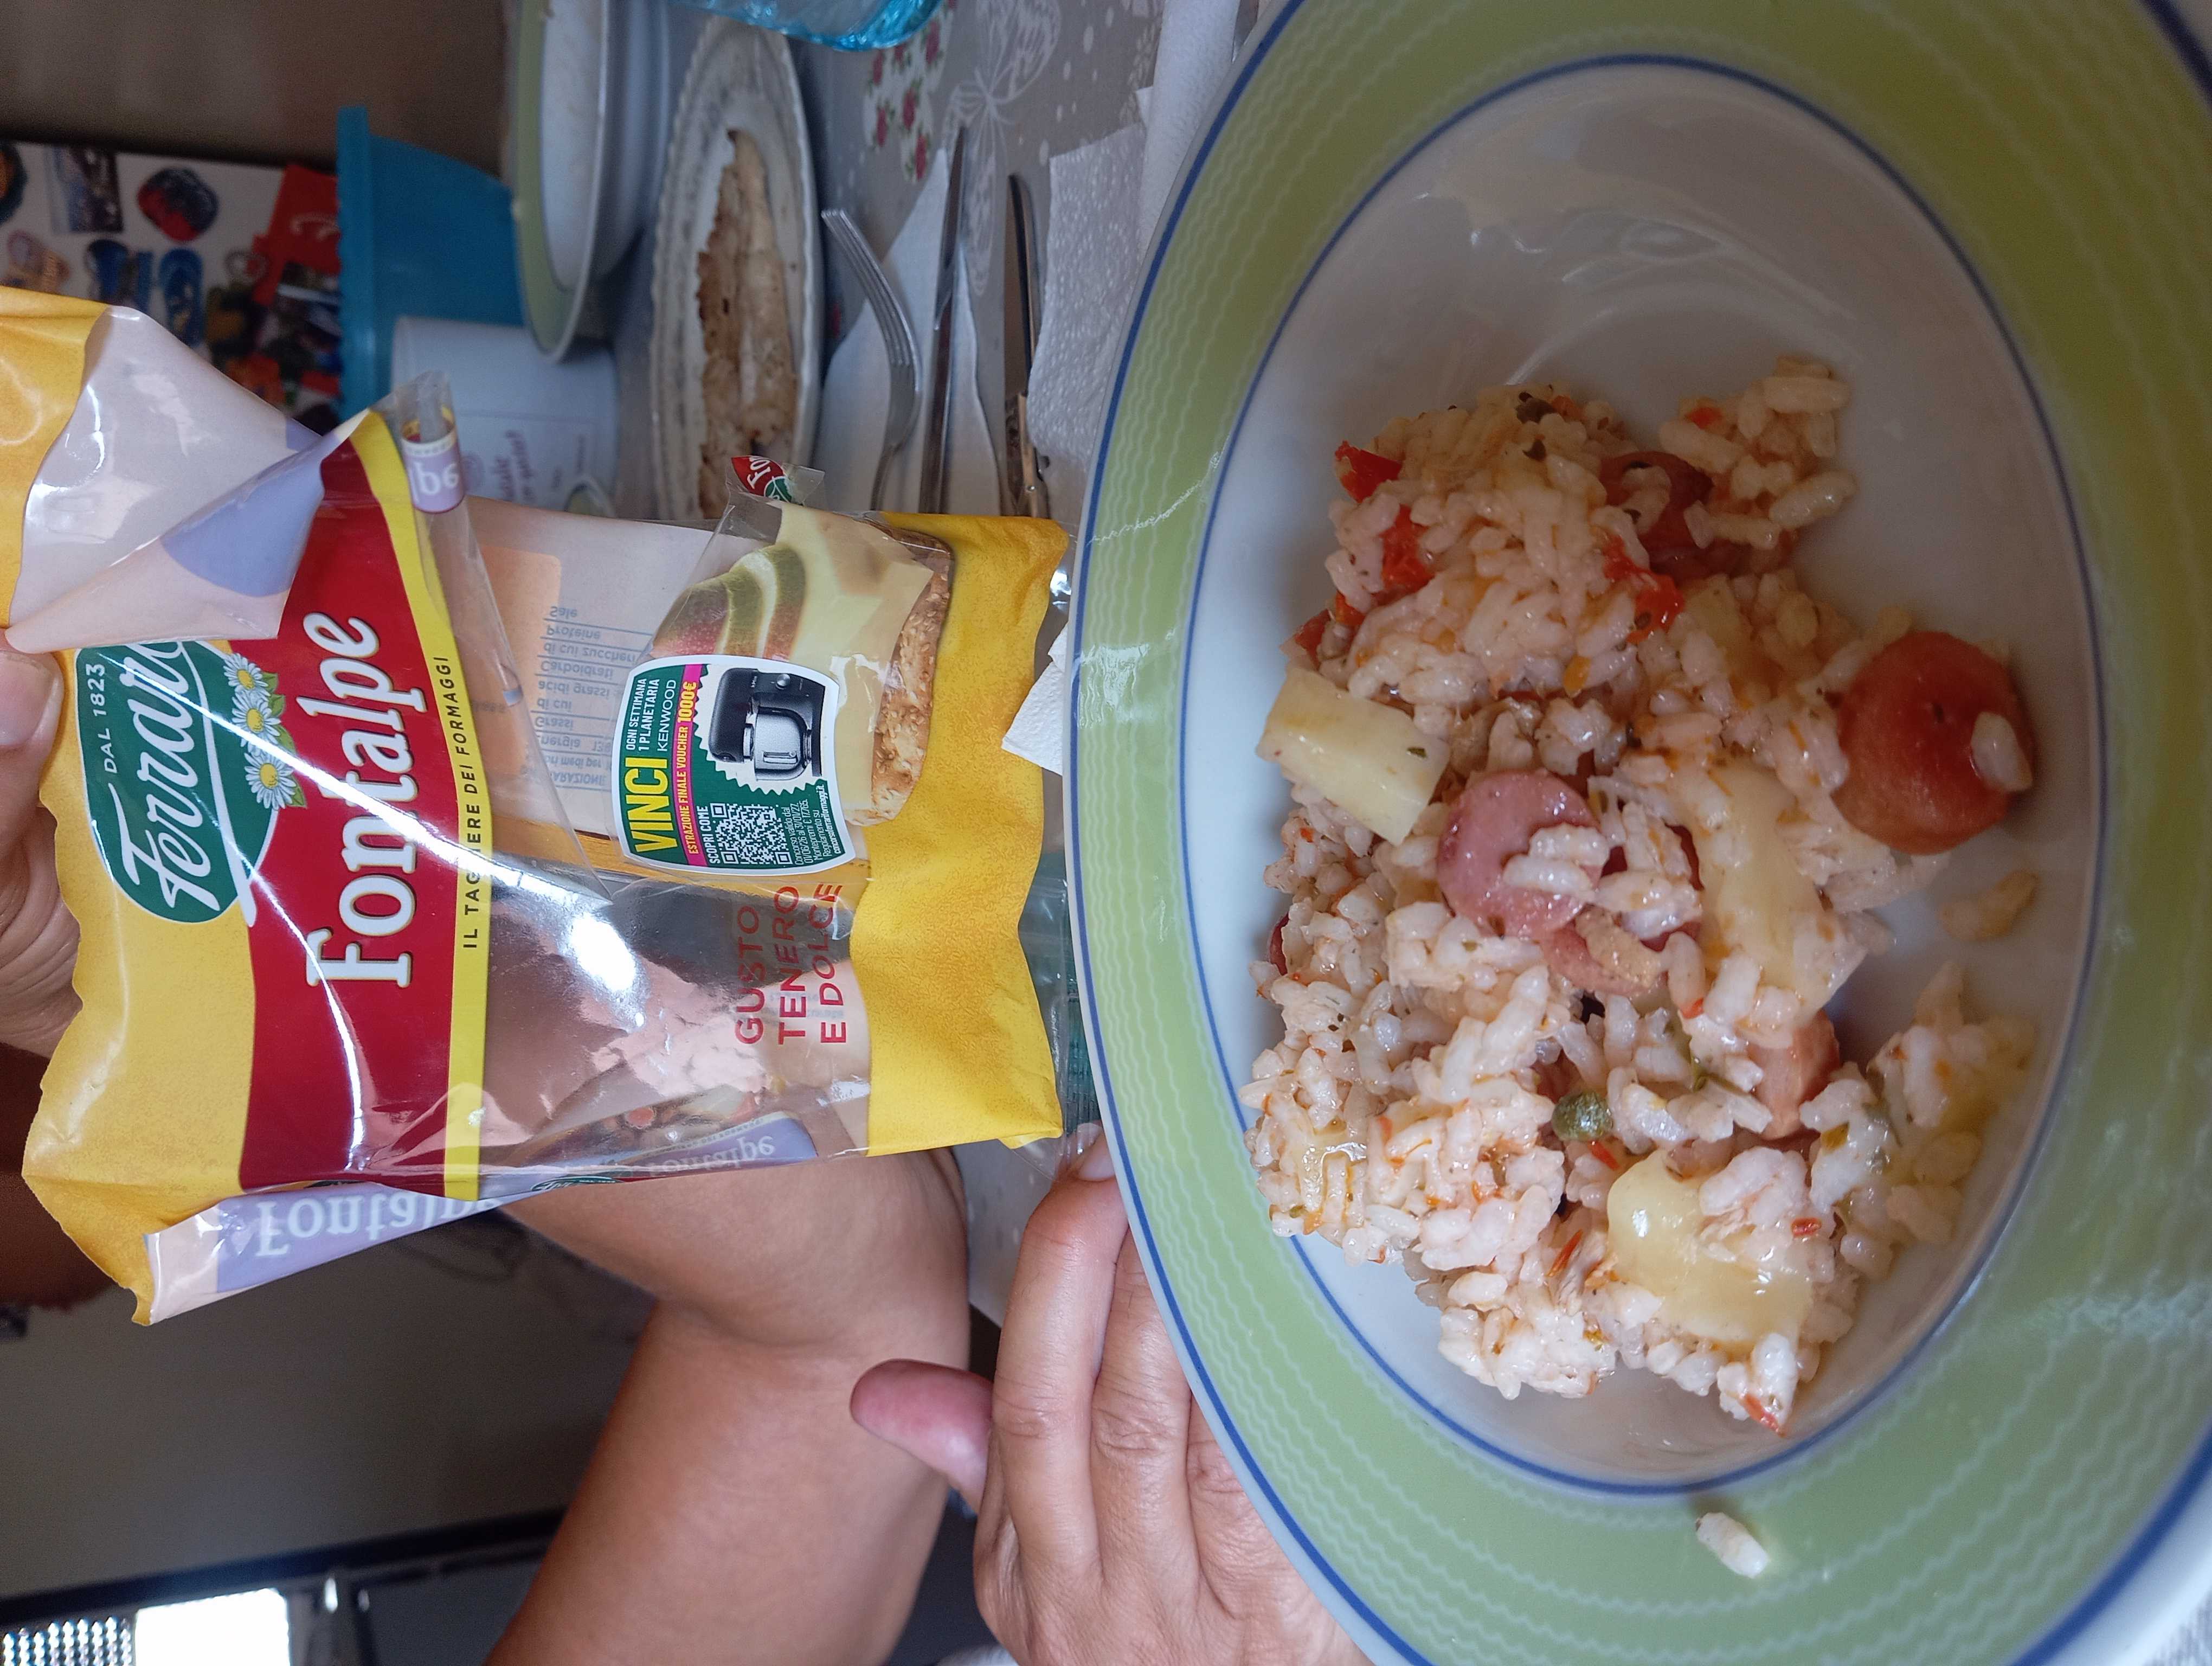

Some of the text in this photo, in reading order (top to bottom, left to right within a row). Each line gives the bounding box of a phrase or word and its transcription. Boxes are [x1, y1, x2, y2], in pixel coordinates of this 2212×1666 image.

[86, 663, 117, 773] DAL 1823
[433, 657, 470, 755] FORMAGGI
[626, 678, 647, 751] OGNI SETTIMANA
[639, 678, 660, 744] PLANETARIA
[657, 680, 677, 752] KENWOOD
[296, 612, 427, 988] Fontalpe
[459, 765, 478, 794] DEI
[676, 681, 699, 854] ESTRAZIONE FINALE VOUCHER 1000€
[625, 757, 678, 853] VINCI
[696, 805, 721, 864] SCOPRI COME
[781, 807, 804, 865] Concorso valido dal
[813, 810, 832, 857] Regolamento su
[798, 836, 813, 863] 01/06/26
[804, 825, 824, 861] Montepremi
[464, 928, 477, 948] IL
[772, 886, 807, 1045] TENERO
[807, 882, 846, 1043] E DOLCE
[735, 905, 767, 1044] GUSTO
